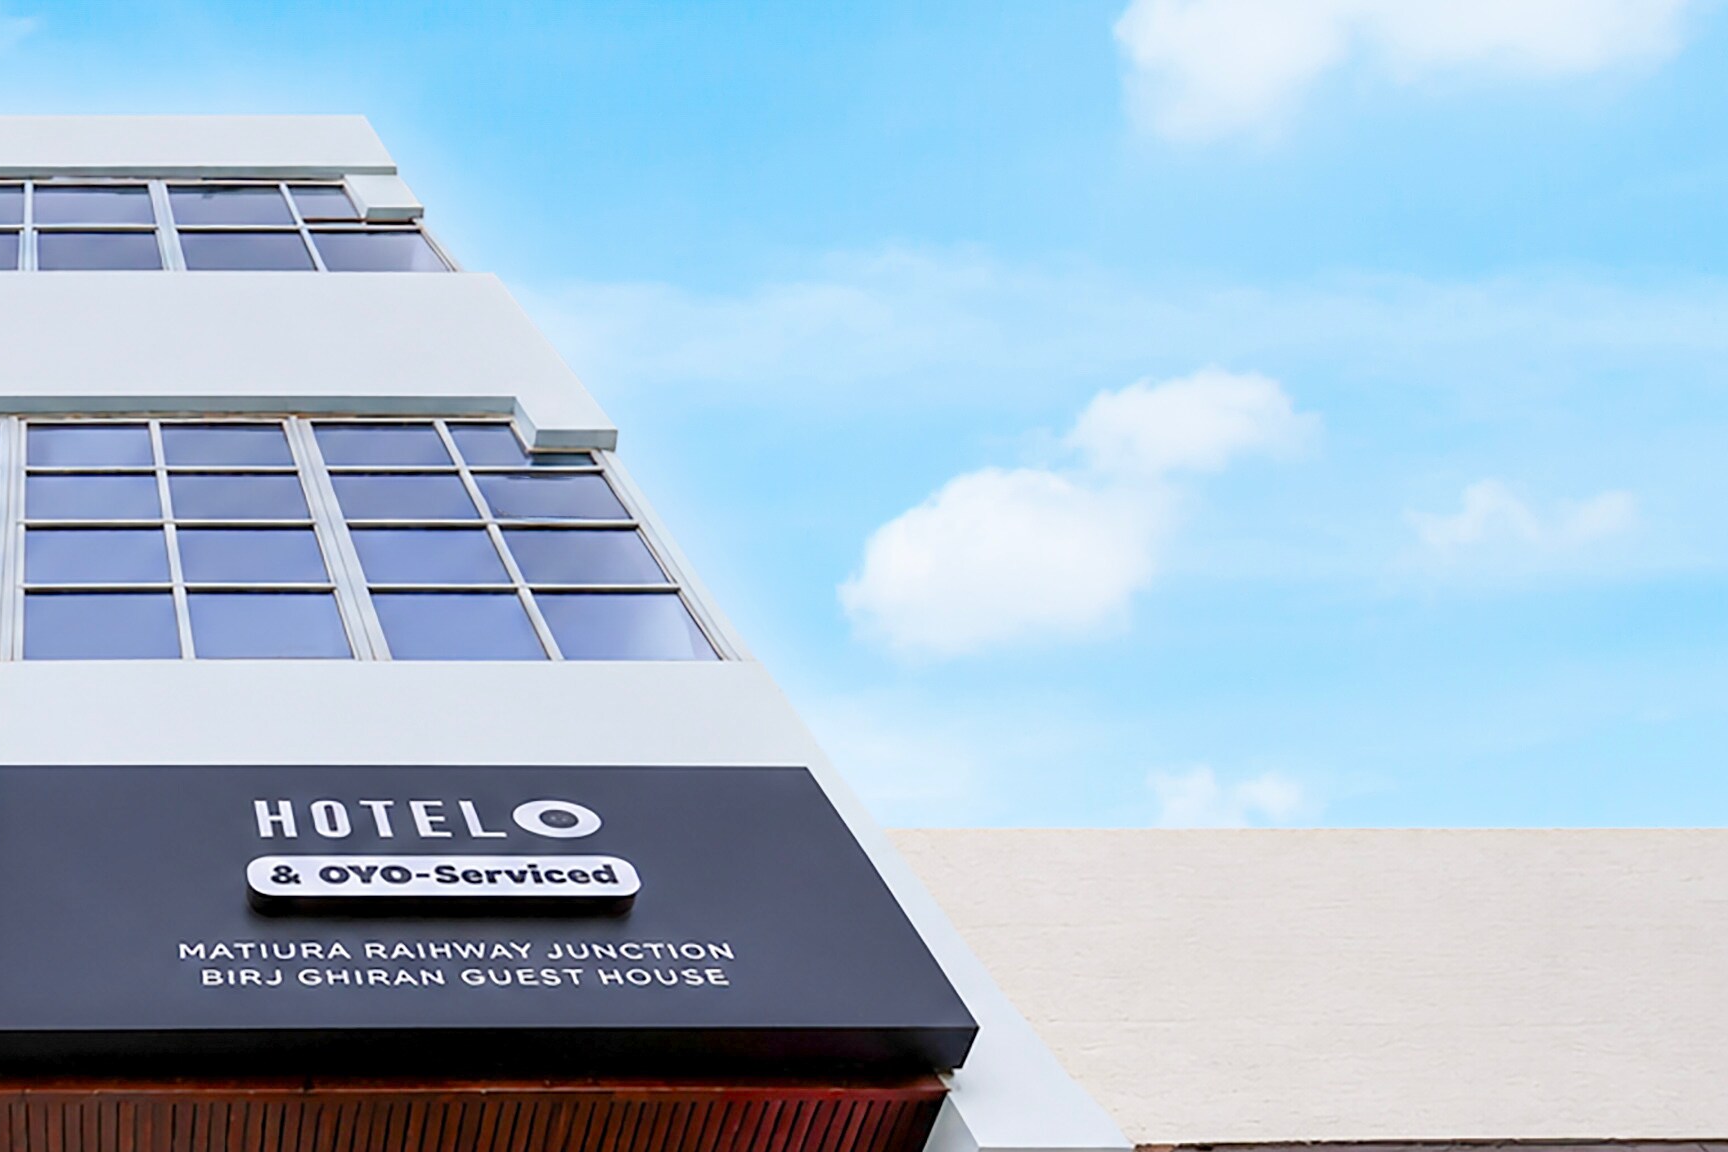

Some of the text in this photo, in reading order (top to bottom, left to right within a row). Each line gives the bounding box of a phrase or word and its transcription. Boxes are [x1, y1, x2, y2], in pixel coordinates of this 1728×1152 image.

[270, 864, 620, 885] & OYO-Serviced
[178, 942, 735, 960] MATIURA RAIHWAY JUNCTION
[201, 968, 731, 986] BIRJ GHIRAN GUEST HOUSE
